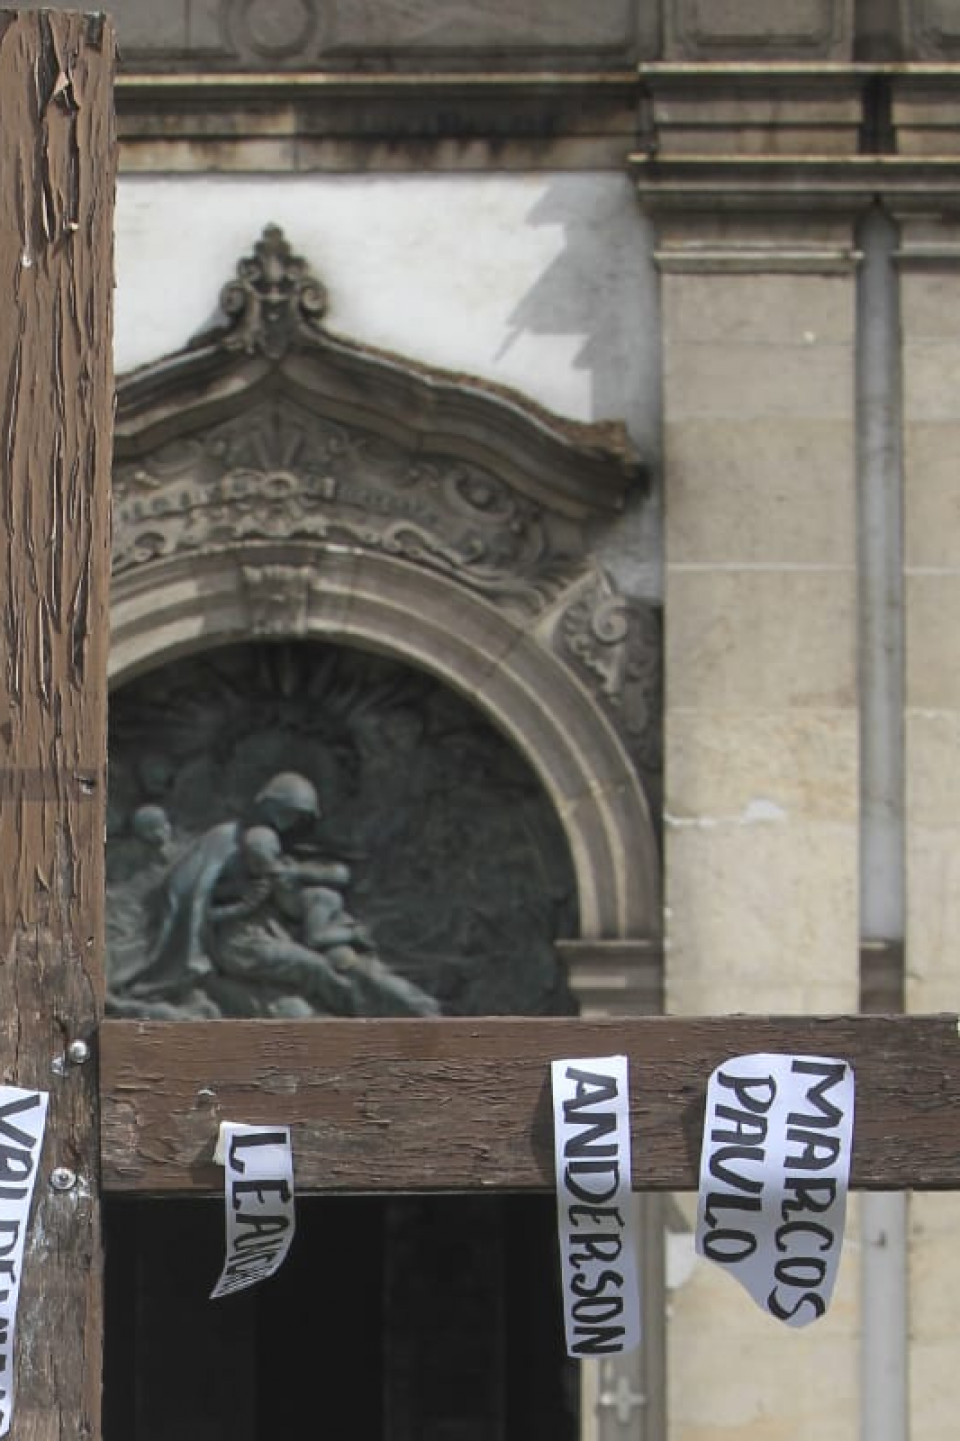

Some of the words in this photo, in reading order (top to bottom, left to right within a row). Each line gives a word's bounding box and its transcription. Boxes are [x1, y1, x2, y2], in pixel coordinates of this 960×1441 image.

[562, 1066, 625, 1354] ANDERSON
[702, 1072, 776, 1263] PAULO
[767, 1060, 846, 1321] MARCOS
